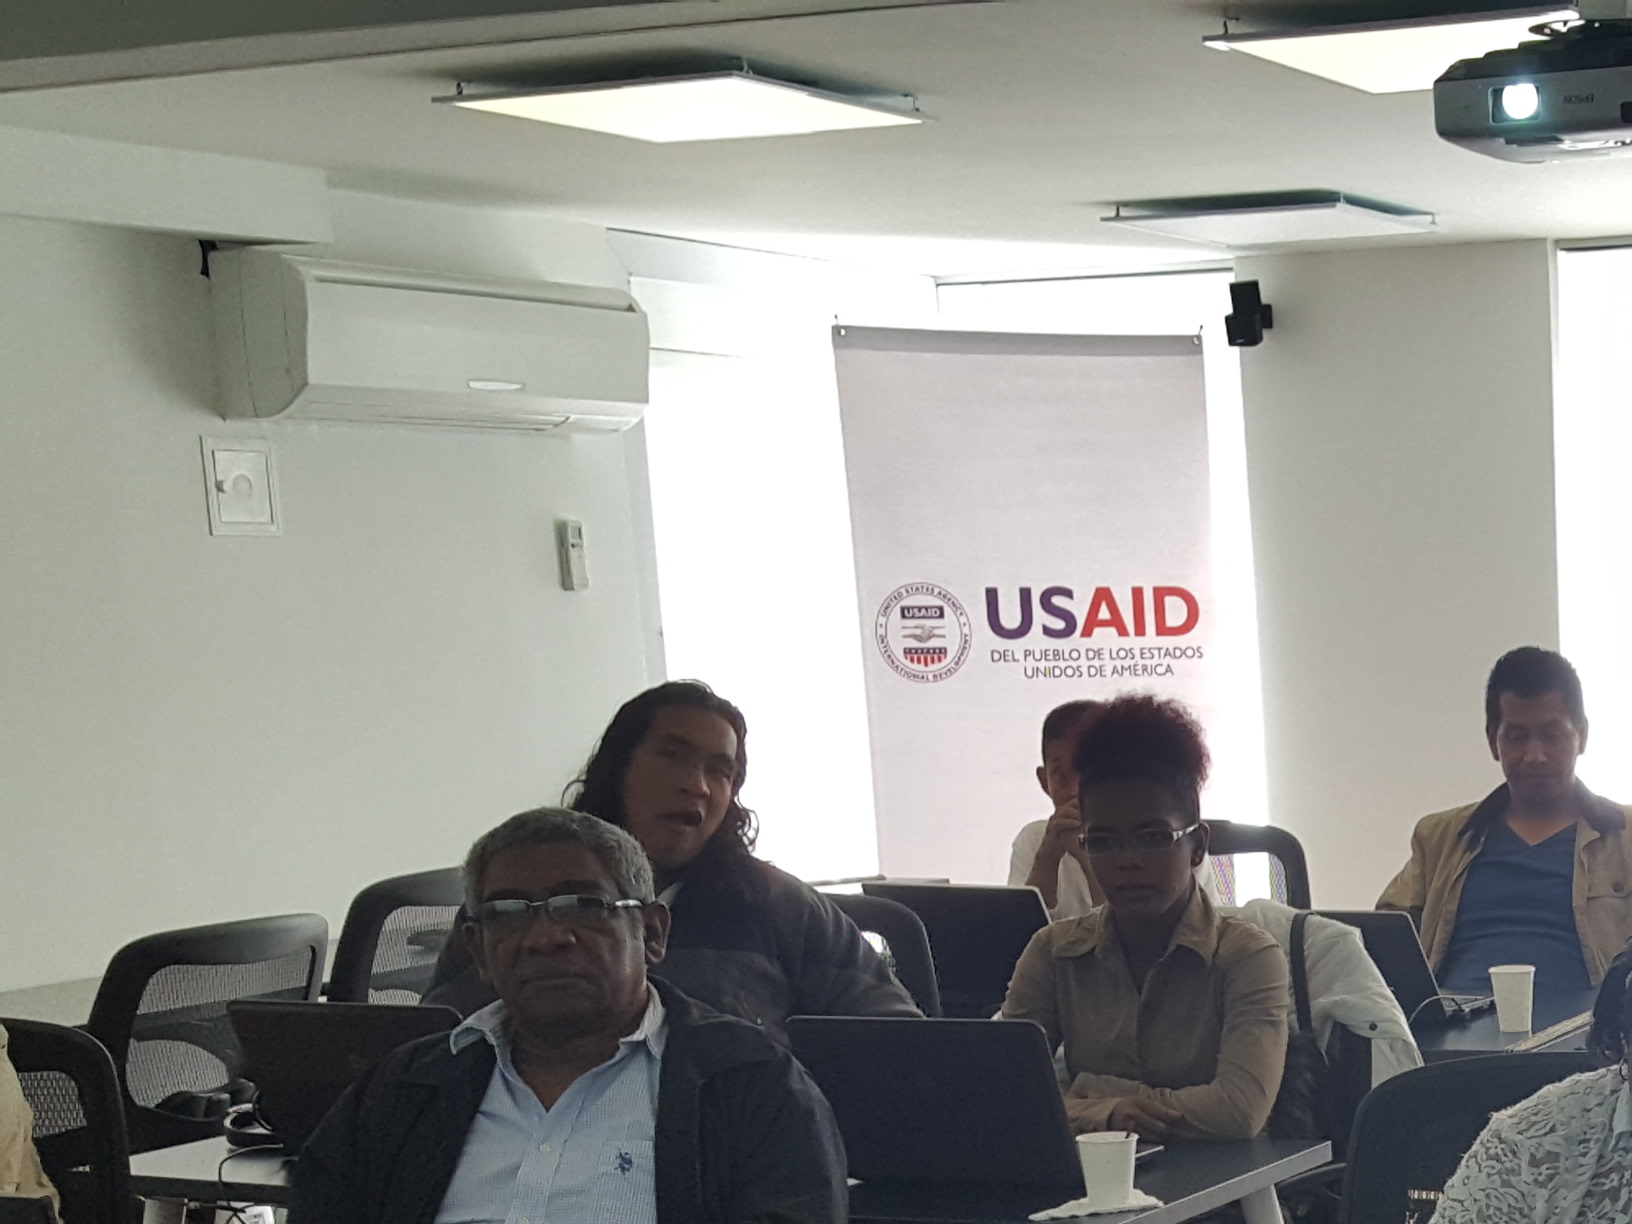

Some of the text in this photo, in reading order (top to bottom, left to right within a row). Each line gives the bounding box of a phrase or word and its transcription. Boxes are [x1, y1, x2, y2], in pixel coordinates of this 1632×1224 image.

[880, 585, 965, 618] UNITED STATES AGENCY
[904, 607, 941, 618] USAID
[985, 586, 1200, 640] USAID
[990, 646, 1204, 663] DEL PUEBLO DE LOS ESTADOS
[1024, 661, 1175, 679] UNIDOS DE AMÉRICA
